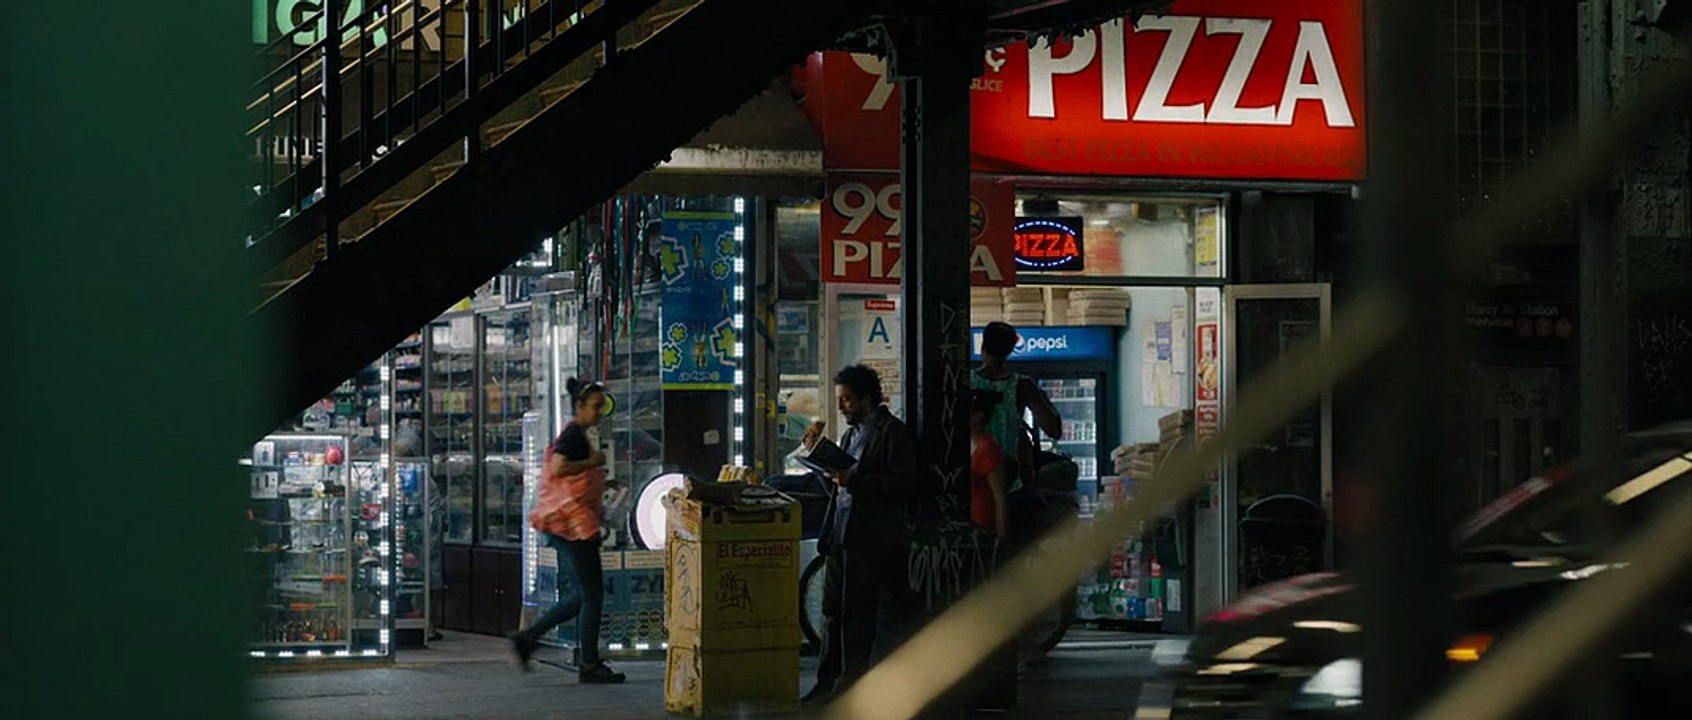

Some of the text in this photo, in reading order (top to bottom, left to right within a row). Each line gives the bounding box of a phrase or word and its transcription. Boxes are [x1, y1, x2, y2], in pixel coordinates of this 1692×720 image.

[1027, 15, 1357, 128] PIZZA
[1024, 138, 1077, 161] BEST
[1086, 139, 1151, 162] PIZZA
[1157, 141, 1182, 164] IN
[1465, 302, 1499, 317] Marcy
[1519, 302, 1559, 316] Station
[868, 316, 890, 343] A
[1027, 335, 1068, 351] pepsi
[719, 543, 729, 558] El
